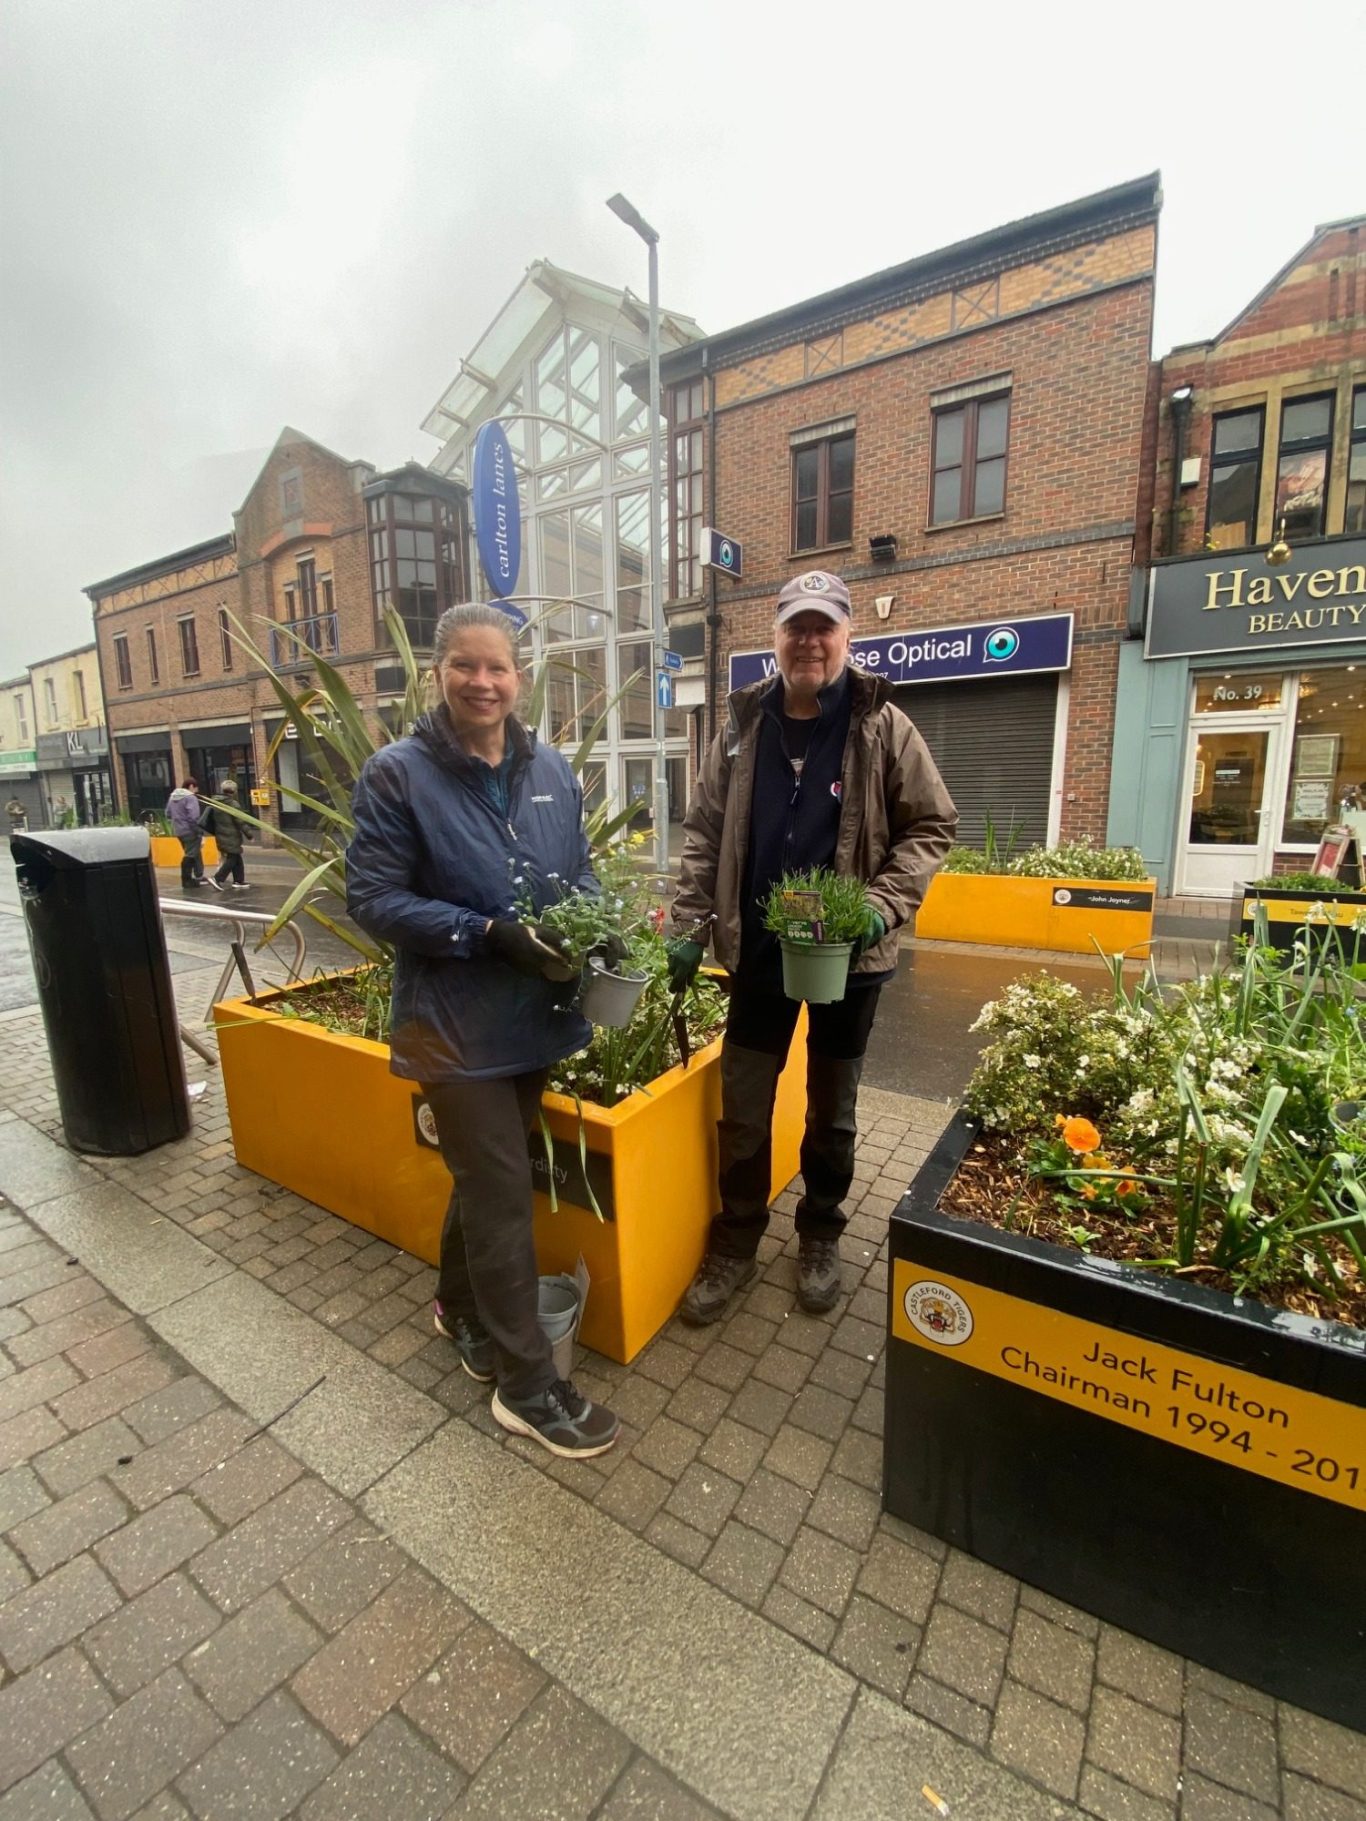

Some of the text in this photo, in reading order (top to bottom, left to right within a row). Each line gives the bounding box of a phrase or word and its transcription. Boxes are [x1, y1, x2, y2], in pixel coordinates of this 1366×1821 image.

[495, 503, 510, 578] carlton
[1202, 564, 1366, 611] Haven
[1247, 603, 1366, 635] BEAUTY
[888, 633, 972, 668] Optical
[1213, 685, 1263, 701] No. 39
[910, 1286, 967, 1333] CASTLEFORD TIGERS
[1083, 1342, 1290, 1429] Jack Fulton
[1000, 1346, 1151, 1418] Chairman
[1167, 1406, 1254, 1454] 1994
[1290, 1448, 1366, 1491] 201
